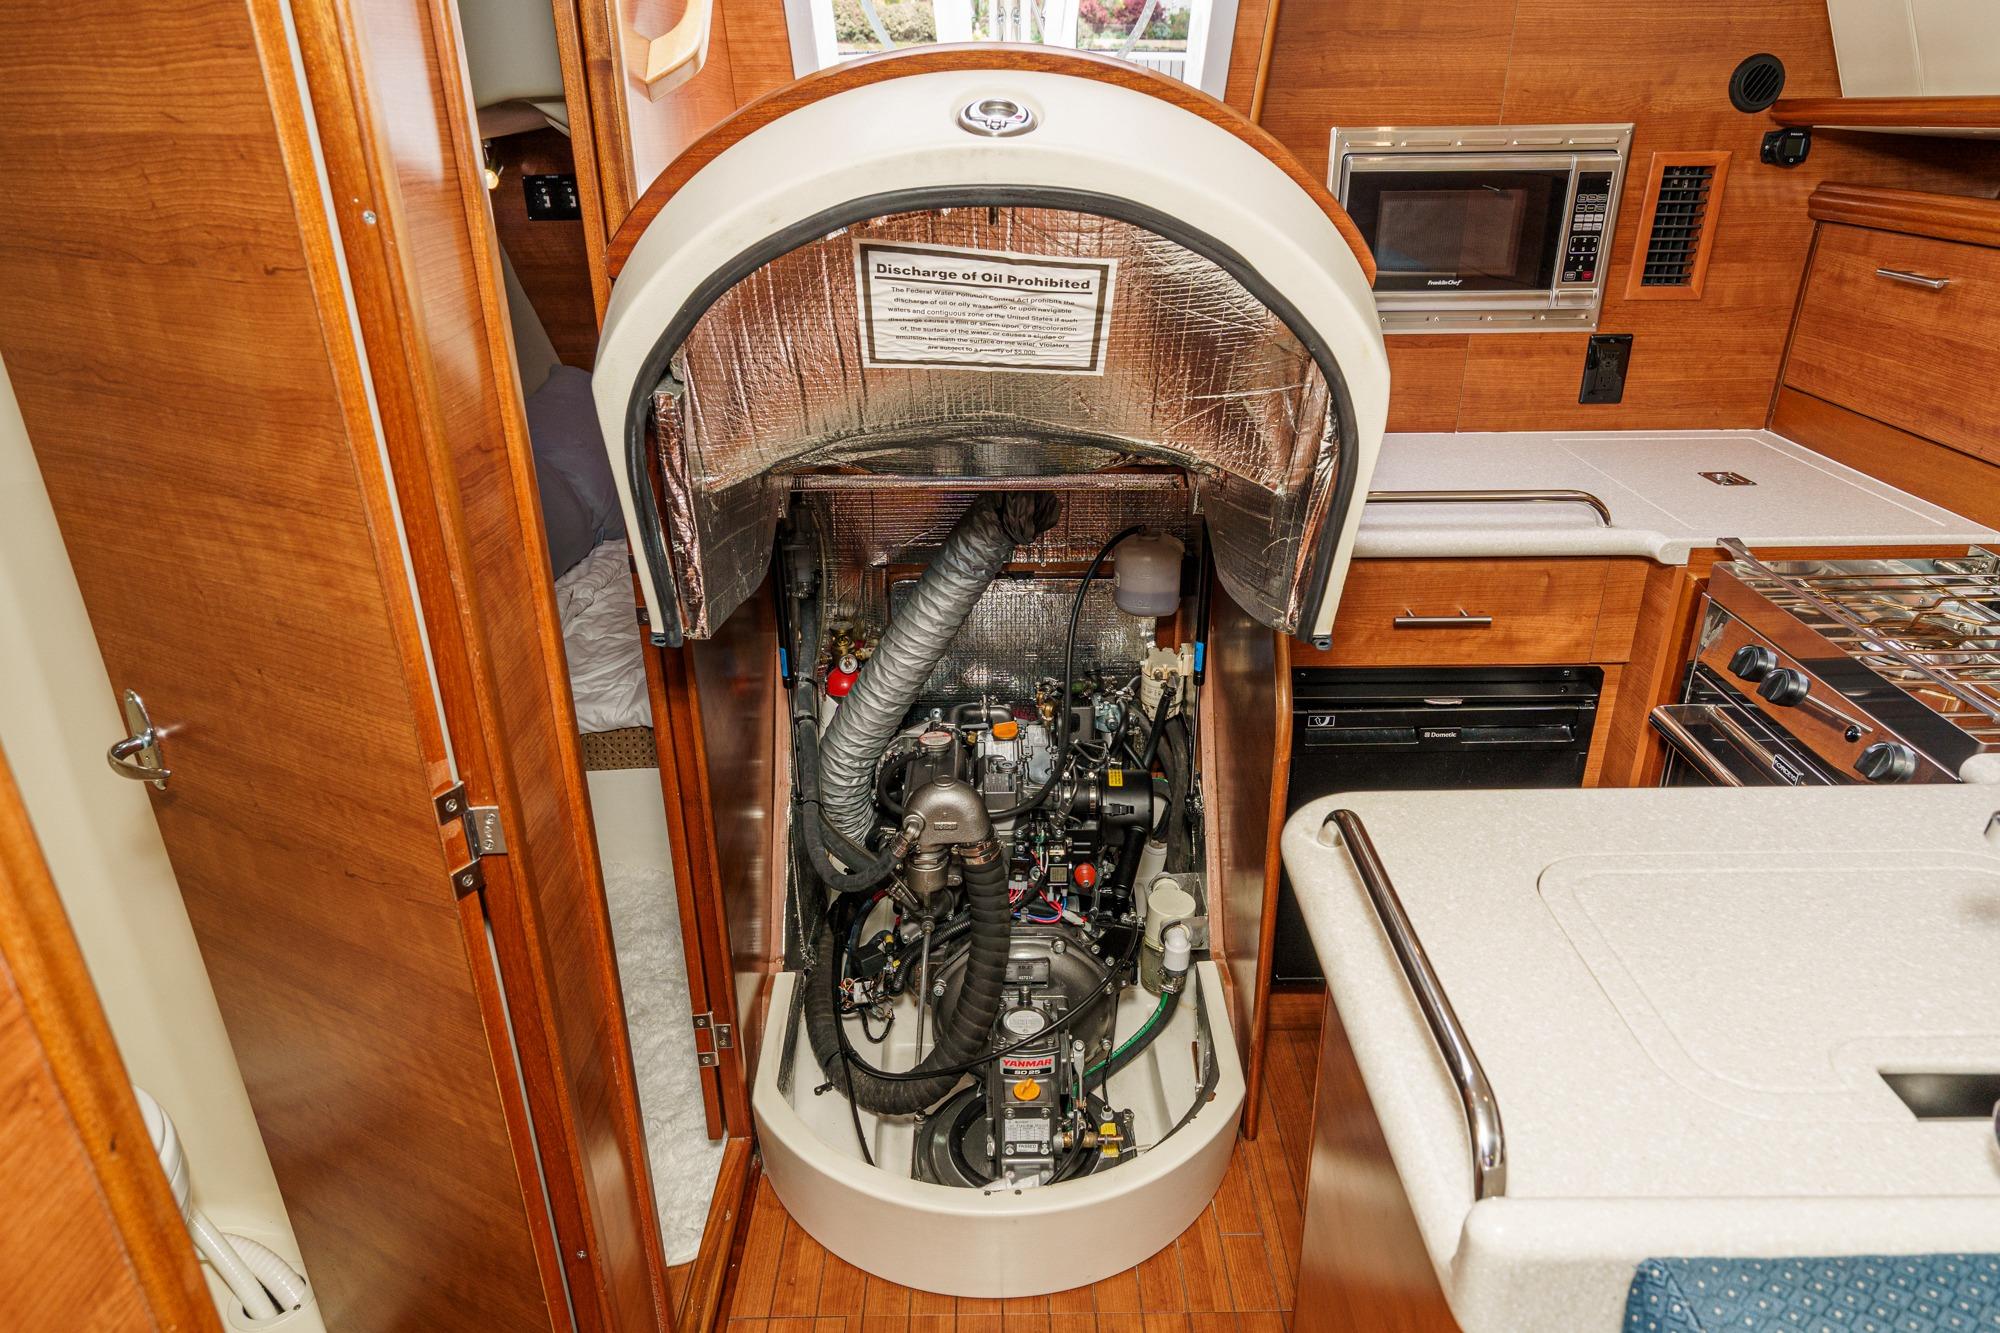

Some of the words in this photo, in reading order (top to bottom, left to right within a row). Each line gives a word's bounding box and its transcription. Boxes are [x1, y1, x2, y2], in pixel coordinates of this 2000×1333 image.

[876, 263, 957, 280] Discharge
[962, 271, 977, 282] of
[981, 273, 1002, 283] Oil
[1008, 276, 1090, 290] Prohibited
[1003, 1058, 1052, 1067] YANMAR
